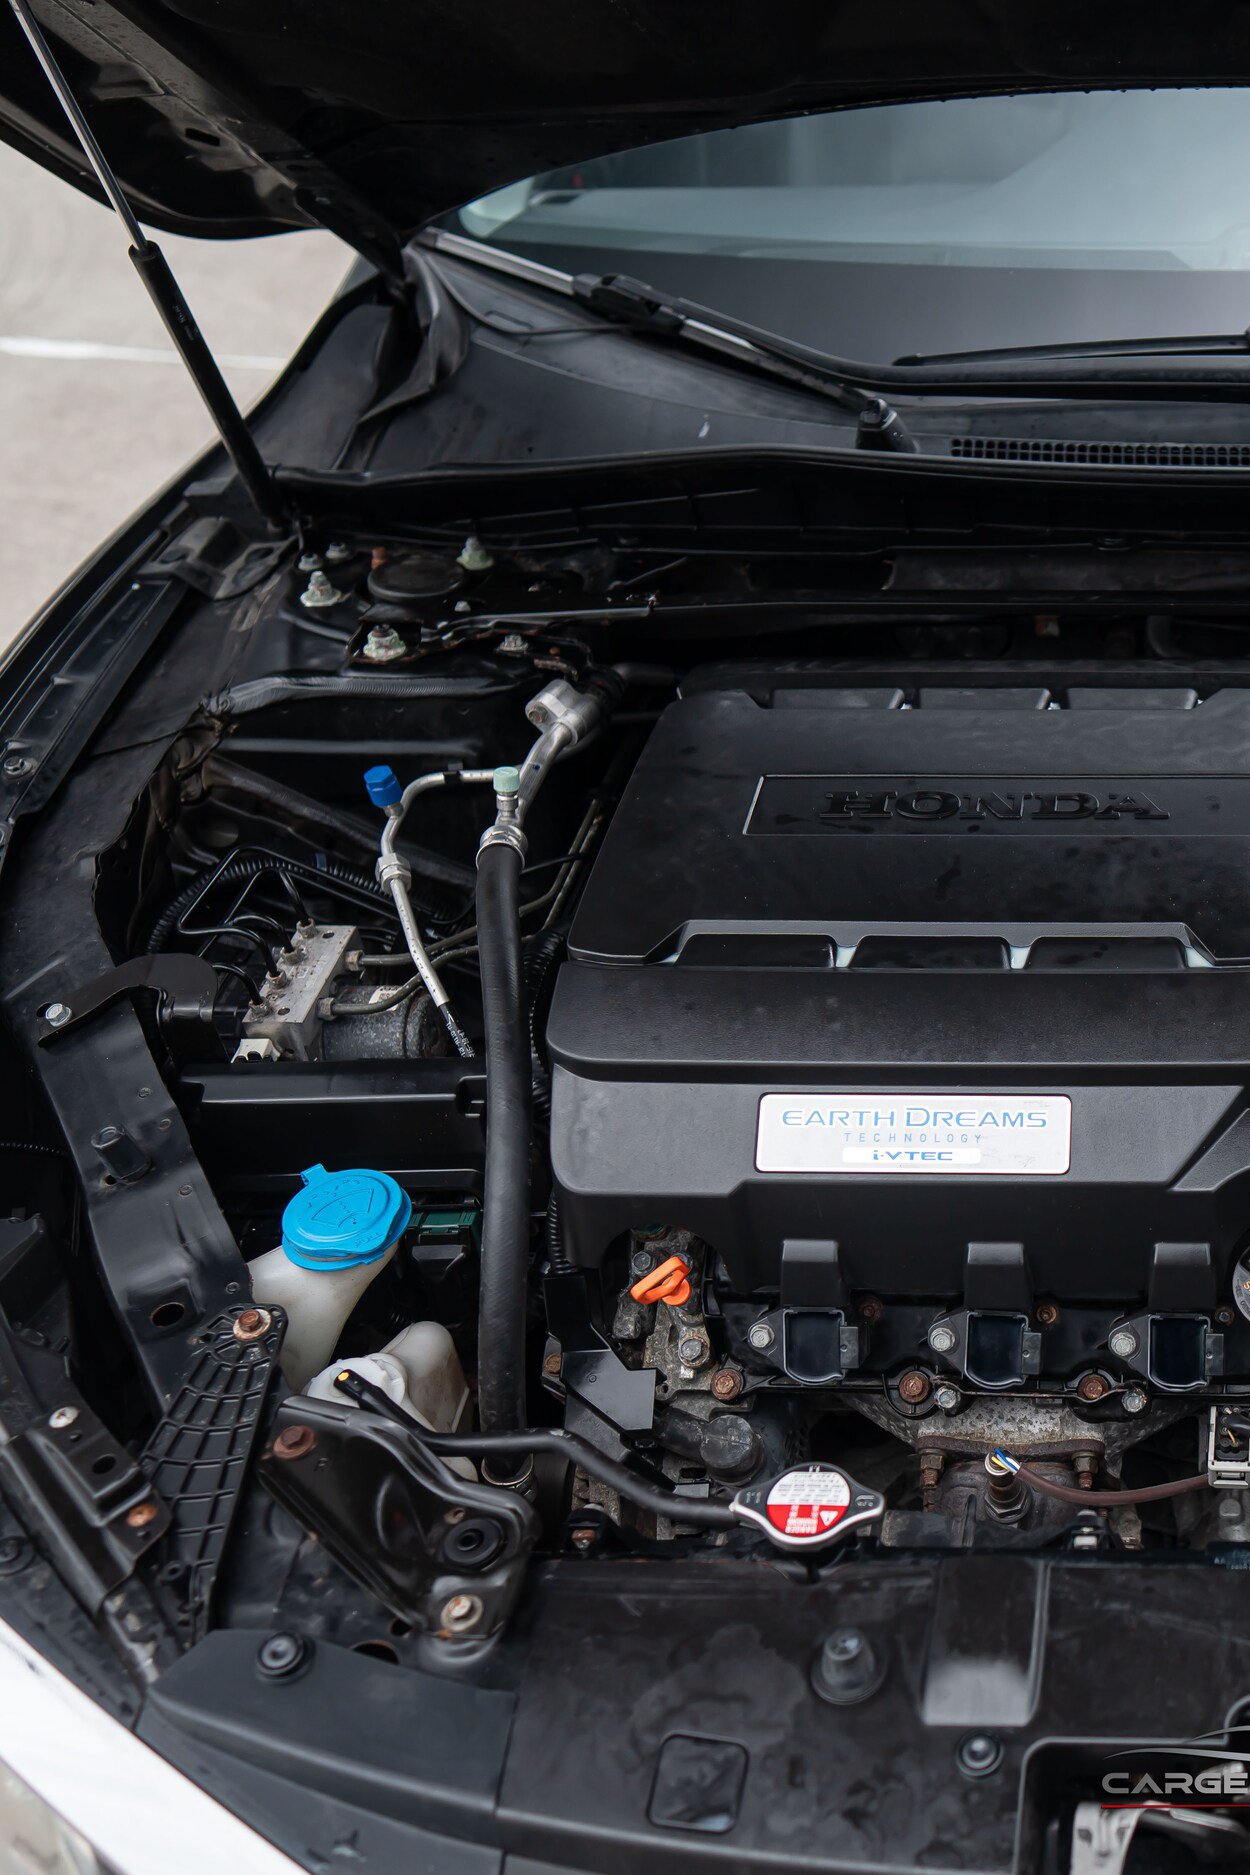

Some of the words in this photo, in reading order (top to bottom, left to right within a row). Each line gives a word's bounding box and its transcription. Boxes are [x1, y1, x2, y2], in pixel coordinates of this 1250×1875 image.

[820, 790, 1171, 821] HONDA
[782, 1109, 896, 1127] EARTH
[905, 1106, 1047, 1128] DREAMS
[844, 1132, 983, 1144] TECHNOLOGY
[872, 1149, 953, 1162] i-VTEC
